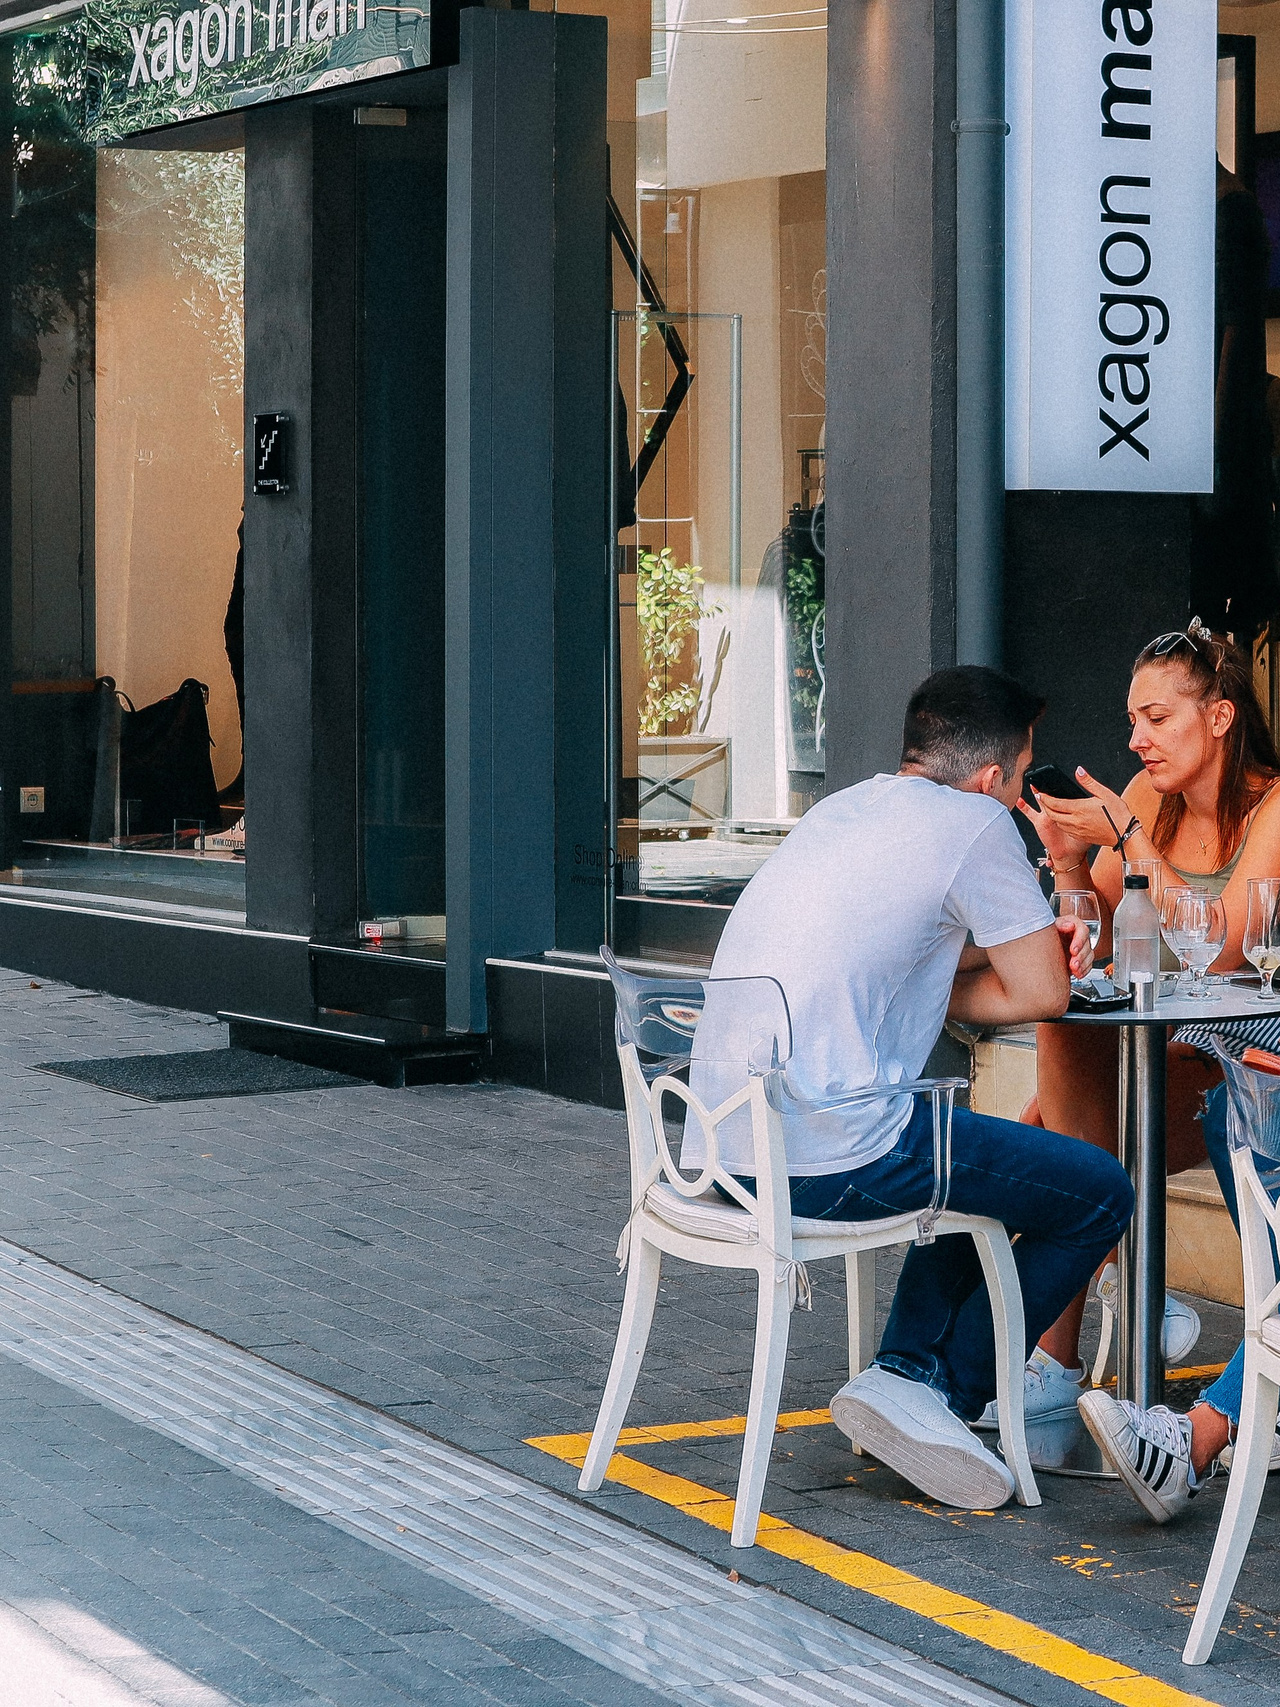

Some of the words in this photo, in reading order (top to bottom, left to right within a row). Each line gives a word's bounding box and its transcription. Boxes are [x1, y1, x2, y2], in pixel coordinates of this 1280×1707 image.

[128, 0, 251, 97] xagon
[267, 0, 367, 51] man
[1100, 0, 1153, 140] ma
[1098, 173, 1170, 462] xagon
[574, 844, 602, 871] Shop
[607, 847, 645, 871] Online
